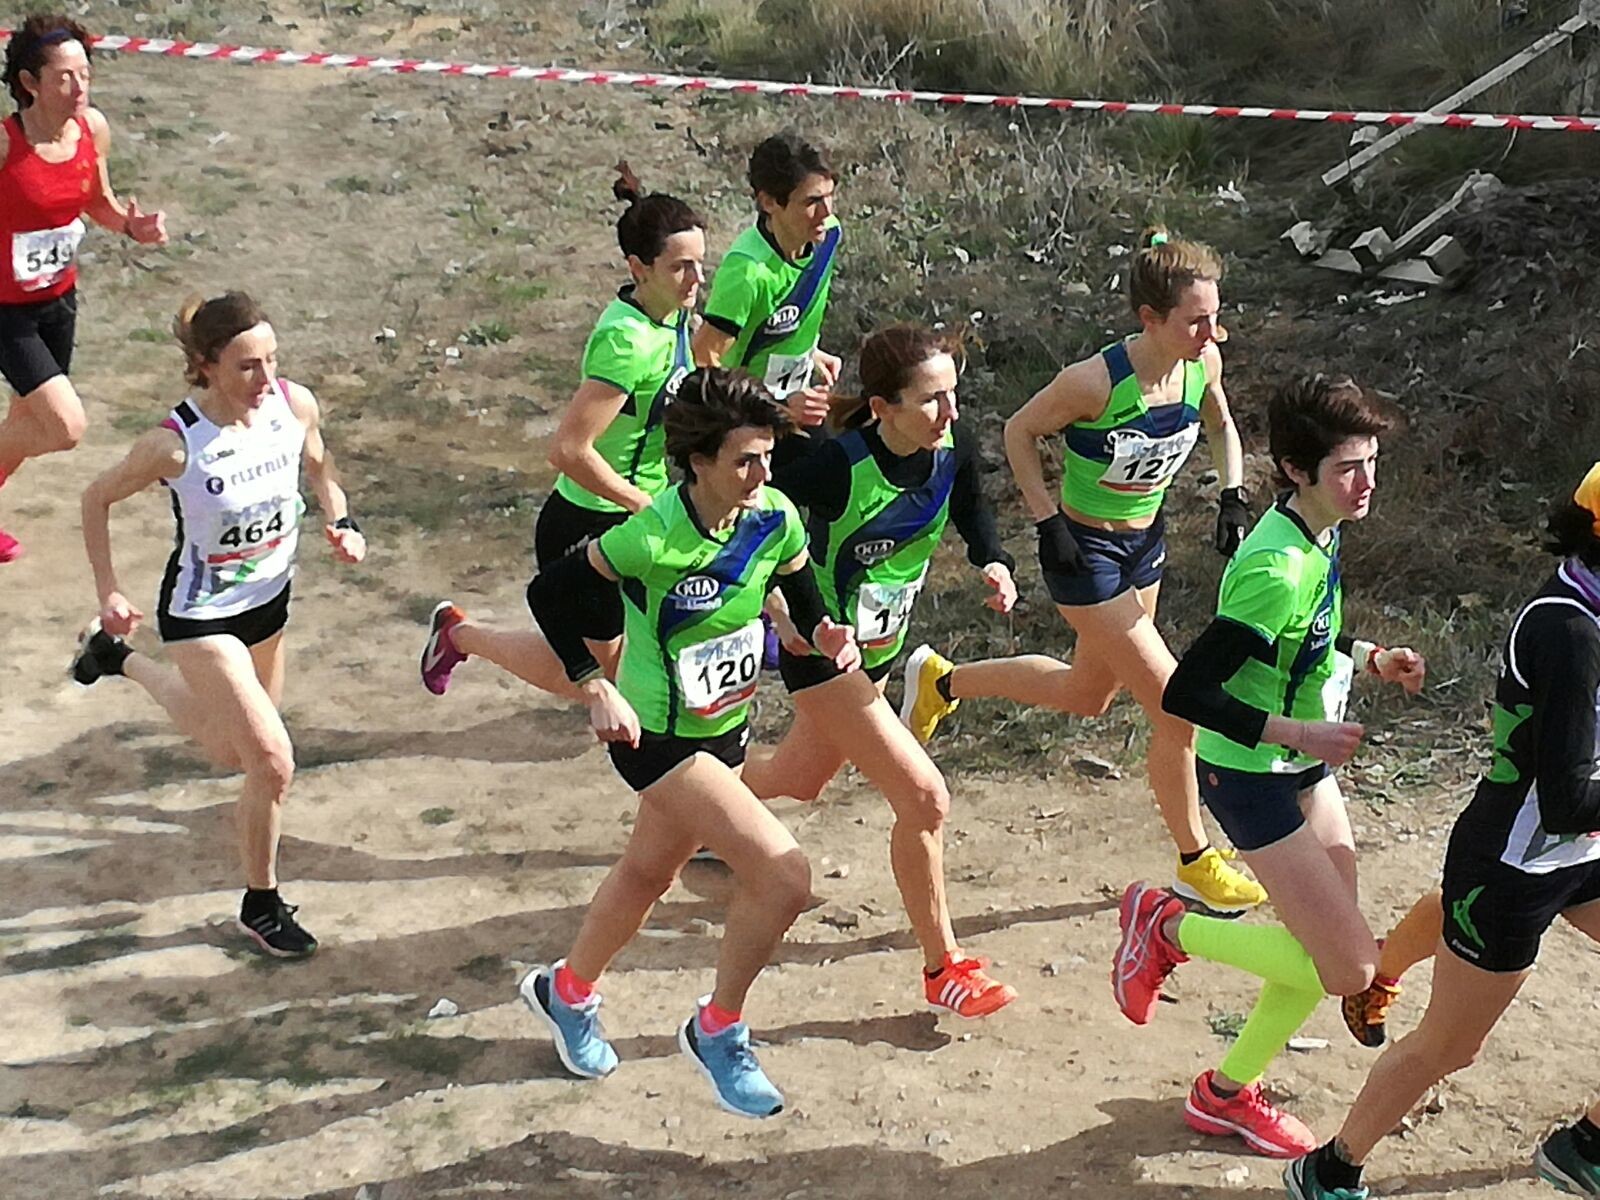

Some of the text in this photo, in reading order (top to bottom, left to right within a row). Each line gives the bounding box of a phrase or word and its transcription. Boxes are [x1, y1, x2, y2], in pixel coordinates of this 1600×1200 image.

[771, 308, 796, 327] KIA
[1123, 451, 1182, 480] 127
[219, 510, 284, 547] 464
[861, 543, 891, 557] KIA
[682, 578, 715, 597] KIA
[697, 652, 756, 695] 120
